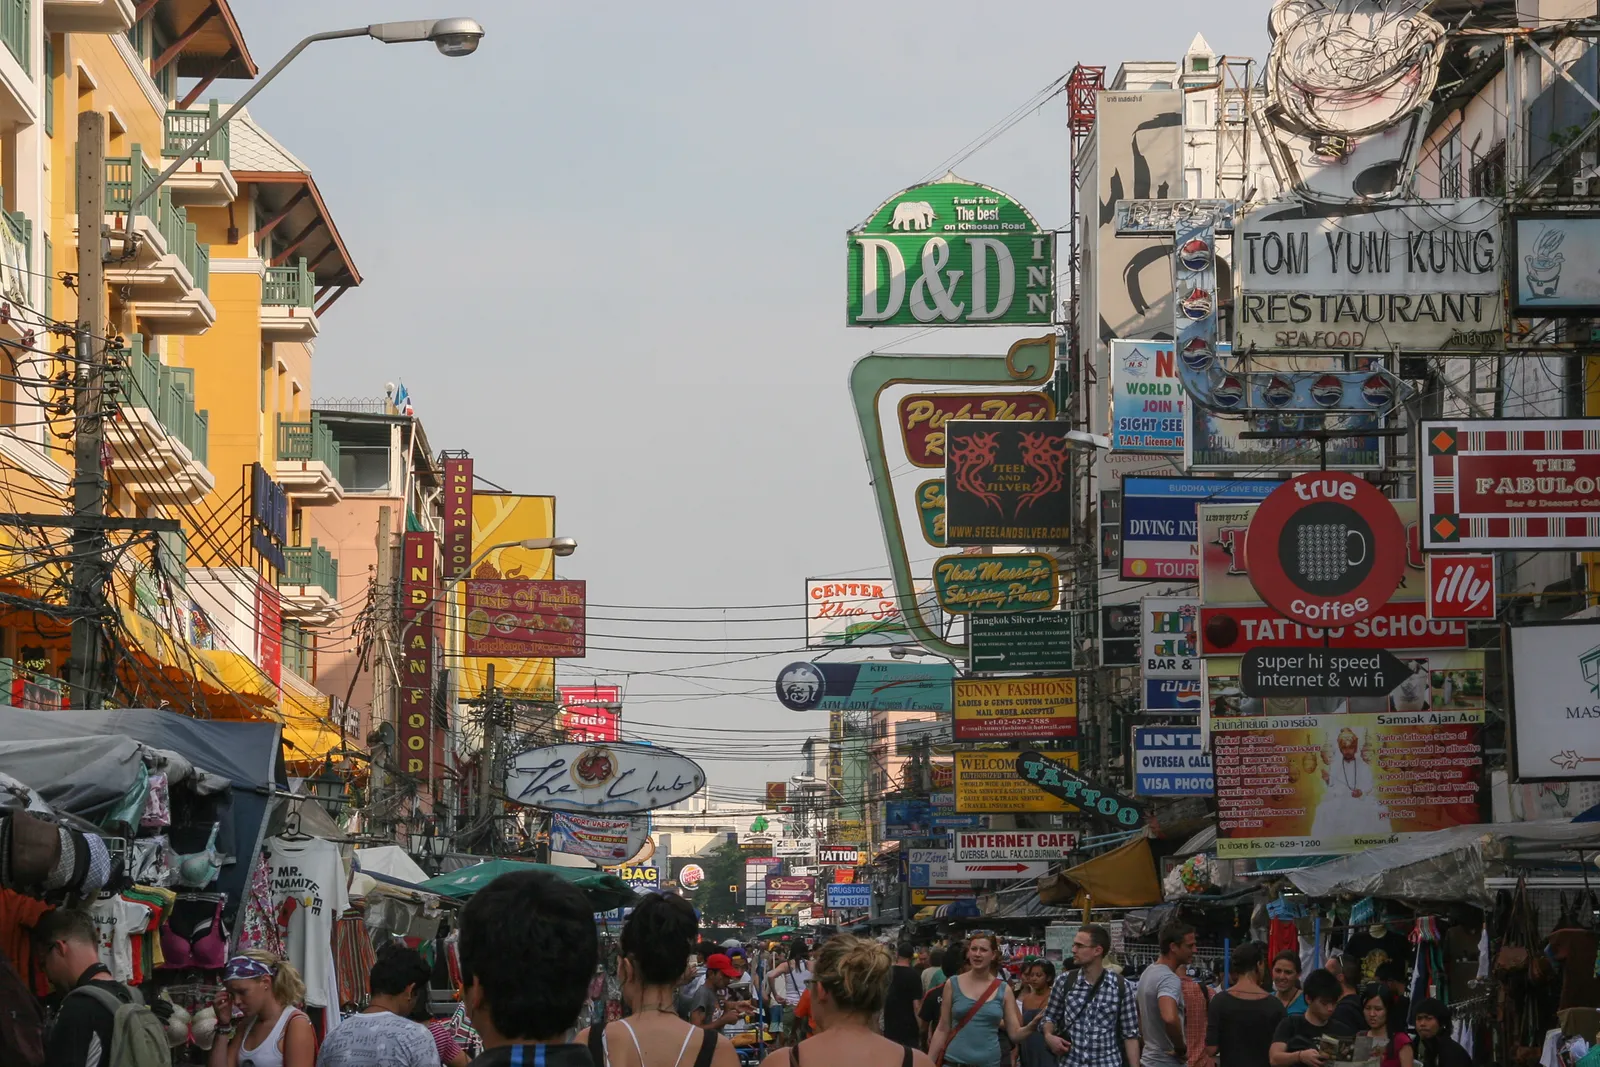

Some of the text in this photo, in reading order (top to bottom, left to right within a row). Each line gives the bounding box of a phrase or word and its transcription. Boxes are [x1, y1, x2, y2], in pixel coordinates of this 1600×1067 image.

[956, 206, 999, 221] The best
[1243, 229, 1495, 275] TOM YUM KUNG
[856, 236, 1016, 323] D&D
[1026, 237, 1050, 315] INN
[1242, 294, 1485, 323] RESTAURANT
[1126, 382, 1172, 396] WORLD
[1142, 400, 1172, 413] JOIN
[1119, 418, 1157, 431] SIGHT
[1119, 435, 1172, 447] T.A.T. License
[991, 464, 1026, 474] STEEL
[1532, 458, 1577, 473] THE
[997, 474, 1021, 482] AND
[985, 482, 1033, 492] SILVER
[1169, 484, 1205, 492] BUDDHA
[1231, 485, 1251, 493] DIVE
[1294, 479, 1357, 500] true
[453, 464, 467, 527] INDIAN
[1505, 500, 1525, 508] Bar
[1539, 499, 1580, 508] Dessert
[949, 526, 1069, 540] WWW.STEELANDSILVER.COM
[1130, 519, 1175, 536] DIVING
[452, 533, 465, 574] FOOD
[938, 562, 1050, 585] Thai Massage
[811, 583, 885, 600] CENTER
[1435, 564, 1491, 612] illy
[470, 586, 581, 611] Taste Of India
[410, 545, 429, 674] INDIAN
[813, 600, 866, 621] Khao
[973, 616, 1010, 627] Bangkok
[1011, 615, 1035, 625] Silver
[1354, 615, 1464, 638] SCHOOL
[1147, 659, 1193, 670] BAR &
[1257, 653, 1381, 674] super hi speed
[1257, 672, 1384, 688] internet & wi fi
[957, 682, 1073, 697] SUNNY FASHIONS
[821, 701, 841, 710] ATM
[848, 700, 870, 710] ADM
[1377, 712, 1480, 725] Samnak Ajan Aor
[1566, 706, 1600, 719] MAS
[408, 690, 425, 773] FOOD
[1434, 732, 1456, 740] series
[1458, 731, 1467, 739] of
[1435, 745, 1445, 754] be
[960, 758, 1018, 770] WELCOM
[1142, 755, 1210, 768] OVERSEA CALL
[1410, 759, 1419, 767] of
[516, 759, 692, 800] The Club
[1143, 777, 1214, 789] VISA PHOTO
[1023, 760, 1140, 826] TATTOO
[1413, 784, 1436, 792] health
[1437, 783, 1453, 791] and
[1459, 795, 1474, 804] and
[777, 840, 801, 848] ZEST
[960, 833, 1075, 848] INTERNET CAFE
[1264, 839, 1321, 849] 02-629-1200
[1354, 837, 1387, 846] Khaosan
[820, 851, 858, 861] TATTOO
[960, 850, 989, 859] OVERSEA
[277, 866, 302, 877] MR.
[621, 868, 657, 881] BAG
[828, 886, 871, 895] DRUGSTORE
